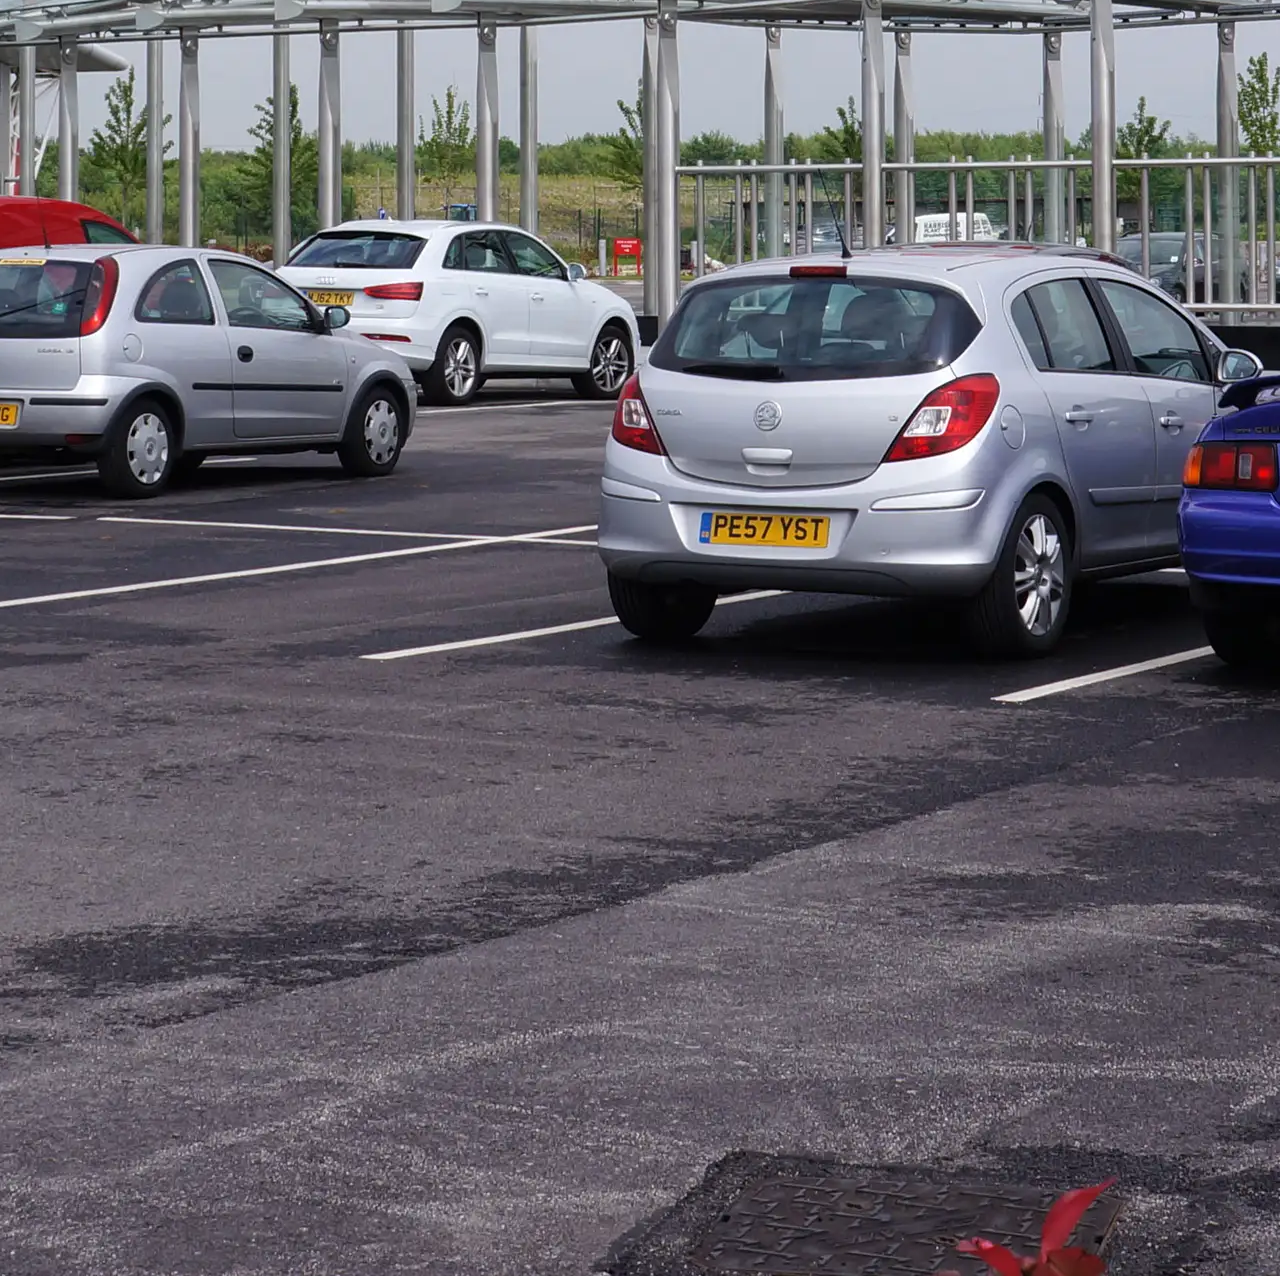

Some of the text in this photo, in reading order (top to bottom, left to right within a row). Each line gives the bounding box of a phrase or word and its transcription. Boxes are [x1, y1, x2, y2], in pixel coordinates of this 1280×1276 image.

[334, 292, 352, 304] TKY
[713, 514, 825, 541] PE57 YST
